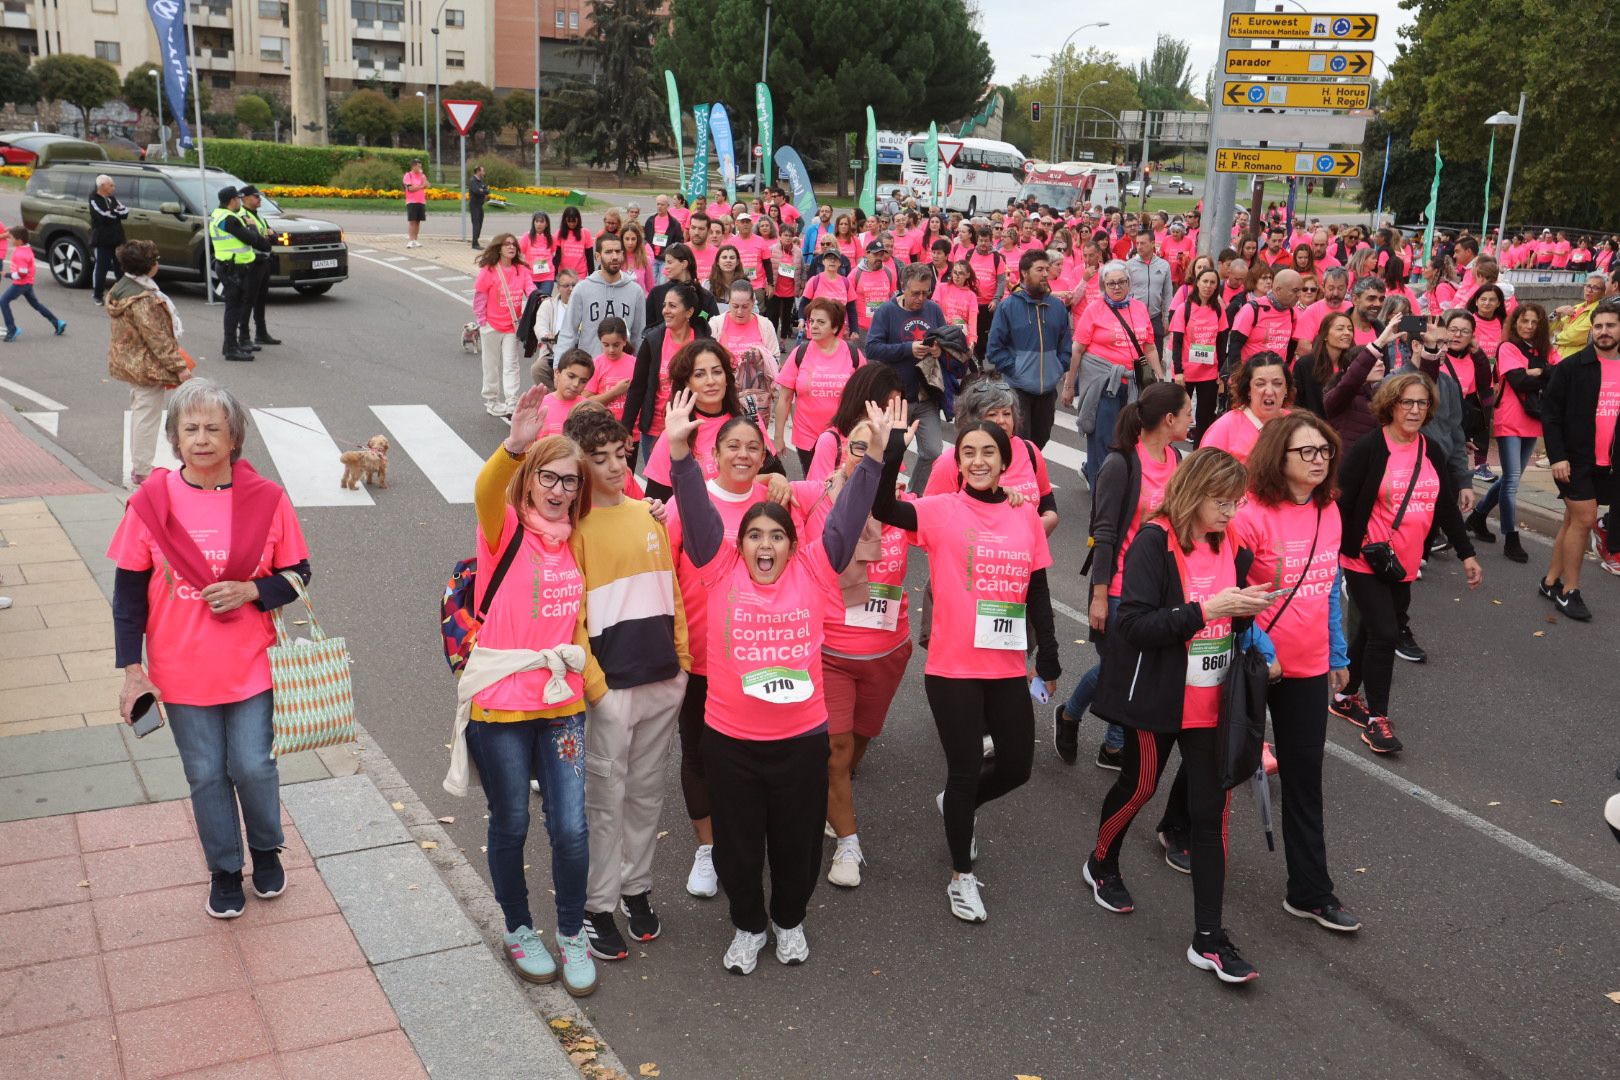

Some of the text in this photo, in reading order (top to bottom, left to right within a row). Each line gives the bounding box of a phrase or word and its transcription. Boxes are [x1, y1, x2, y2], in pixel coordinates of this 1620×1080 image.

[1232, 17, 1298, 26] H. Eurowest
[1229, 58, 1271, 68] parador
[1322, 88, 1366, 96] H. Horus
[1337, 97, 1365, 107] Regio
[1244, 162, 1282, 170] Romano
[590, 300, 630, 322] GAP
[811, 388, 840, 397] cánc
[882, 531, 902, 544] cha
[977, 545, 994, 558] En
[866, 560, 903, 574] ncer
[1286, 556, 1300, 568] En
[544, 570, 558, 582] En
[975, 563, 1024, 576] contra
[864, 598, 887, 614] 1713
[734, 608, 811, 624] En marcha
[732, 622, 810, 641] contra el
[993, 618, 1012, 633] 1711
[734, 642, 811, 661] cáncer
[1202, 654, 1228, 671] 8601
[763, 679, 794, 694] 1710
